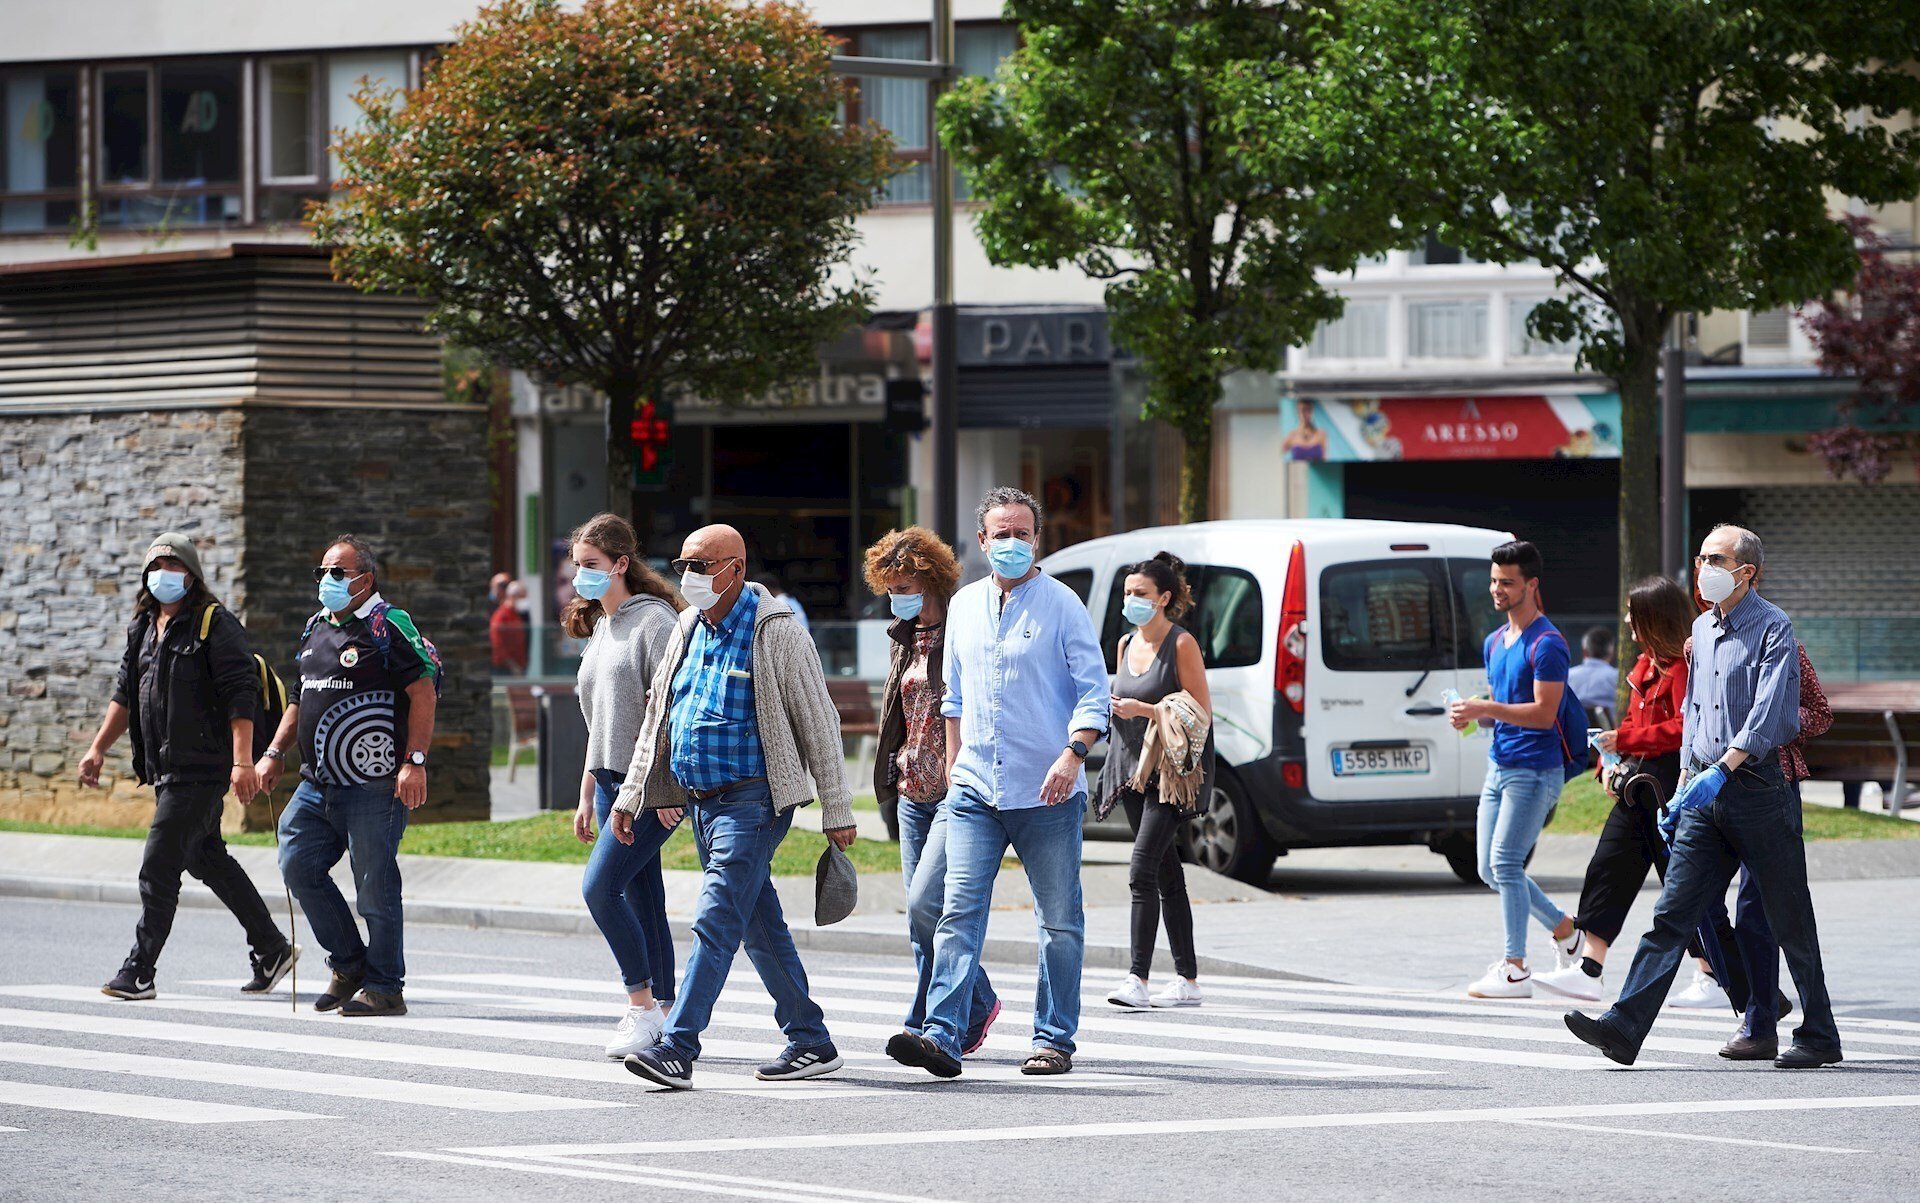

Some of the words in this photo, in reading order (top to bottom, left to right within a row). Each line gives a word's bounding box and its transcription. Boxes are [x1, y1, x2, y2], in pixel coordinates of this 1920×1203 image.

[180, 90, 218, 133] AD
[981, 317, 1114, 361] PAR
[1422, 421, 1519, 443] ARESSO
[1345, 749, 1389, 770] 5585
[1392, 749, 1424, 768] HKP
